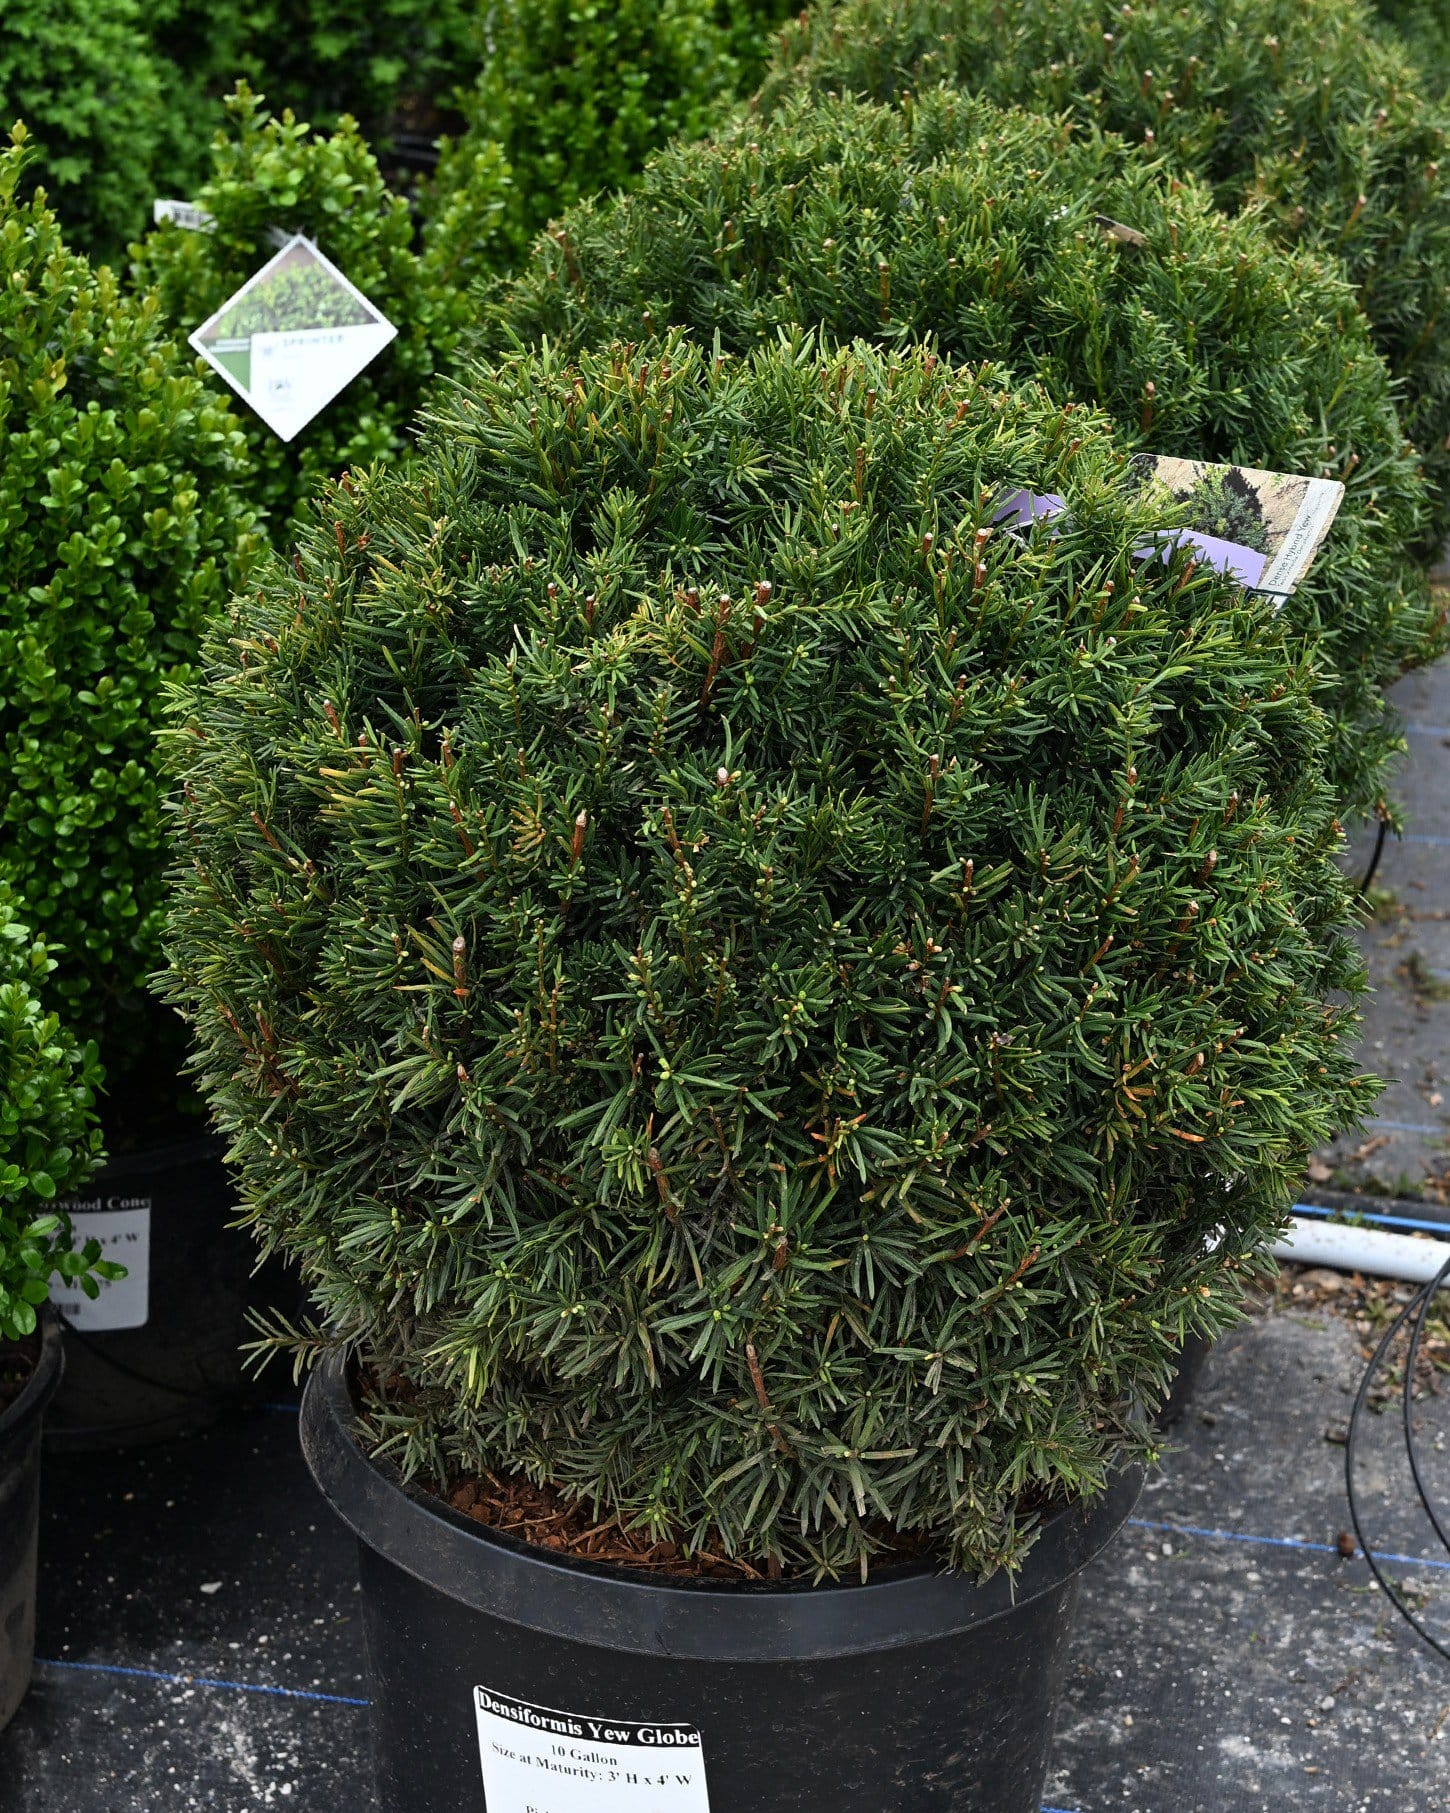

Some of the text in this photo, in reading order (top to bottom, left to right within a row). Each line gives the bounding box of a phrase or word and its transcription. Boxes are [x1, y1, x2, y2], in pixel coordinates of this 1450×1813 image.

[1268, 560, 1288, 586] Dense
[1285, 533, 1303, 560] Hybrid
[1297, 514, 1312, 533] Yew
[479, 1691, 699, 1745] Densiformis Yew Globe
[491, 1741, 692, 1786] Size at Maturity: 3' H x 4' W
[551, 1745, 618, 1766] 10 Gallon
